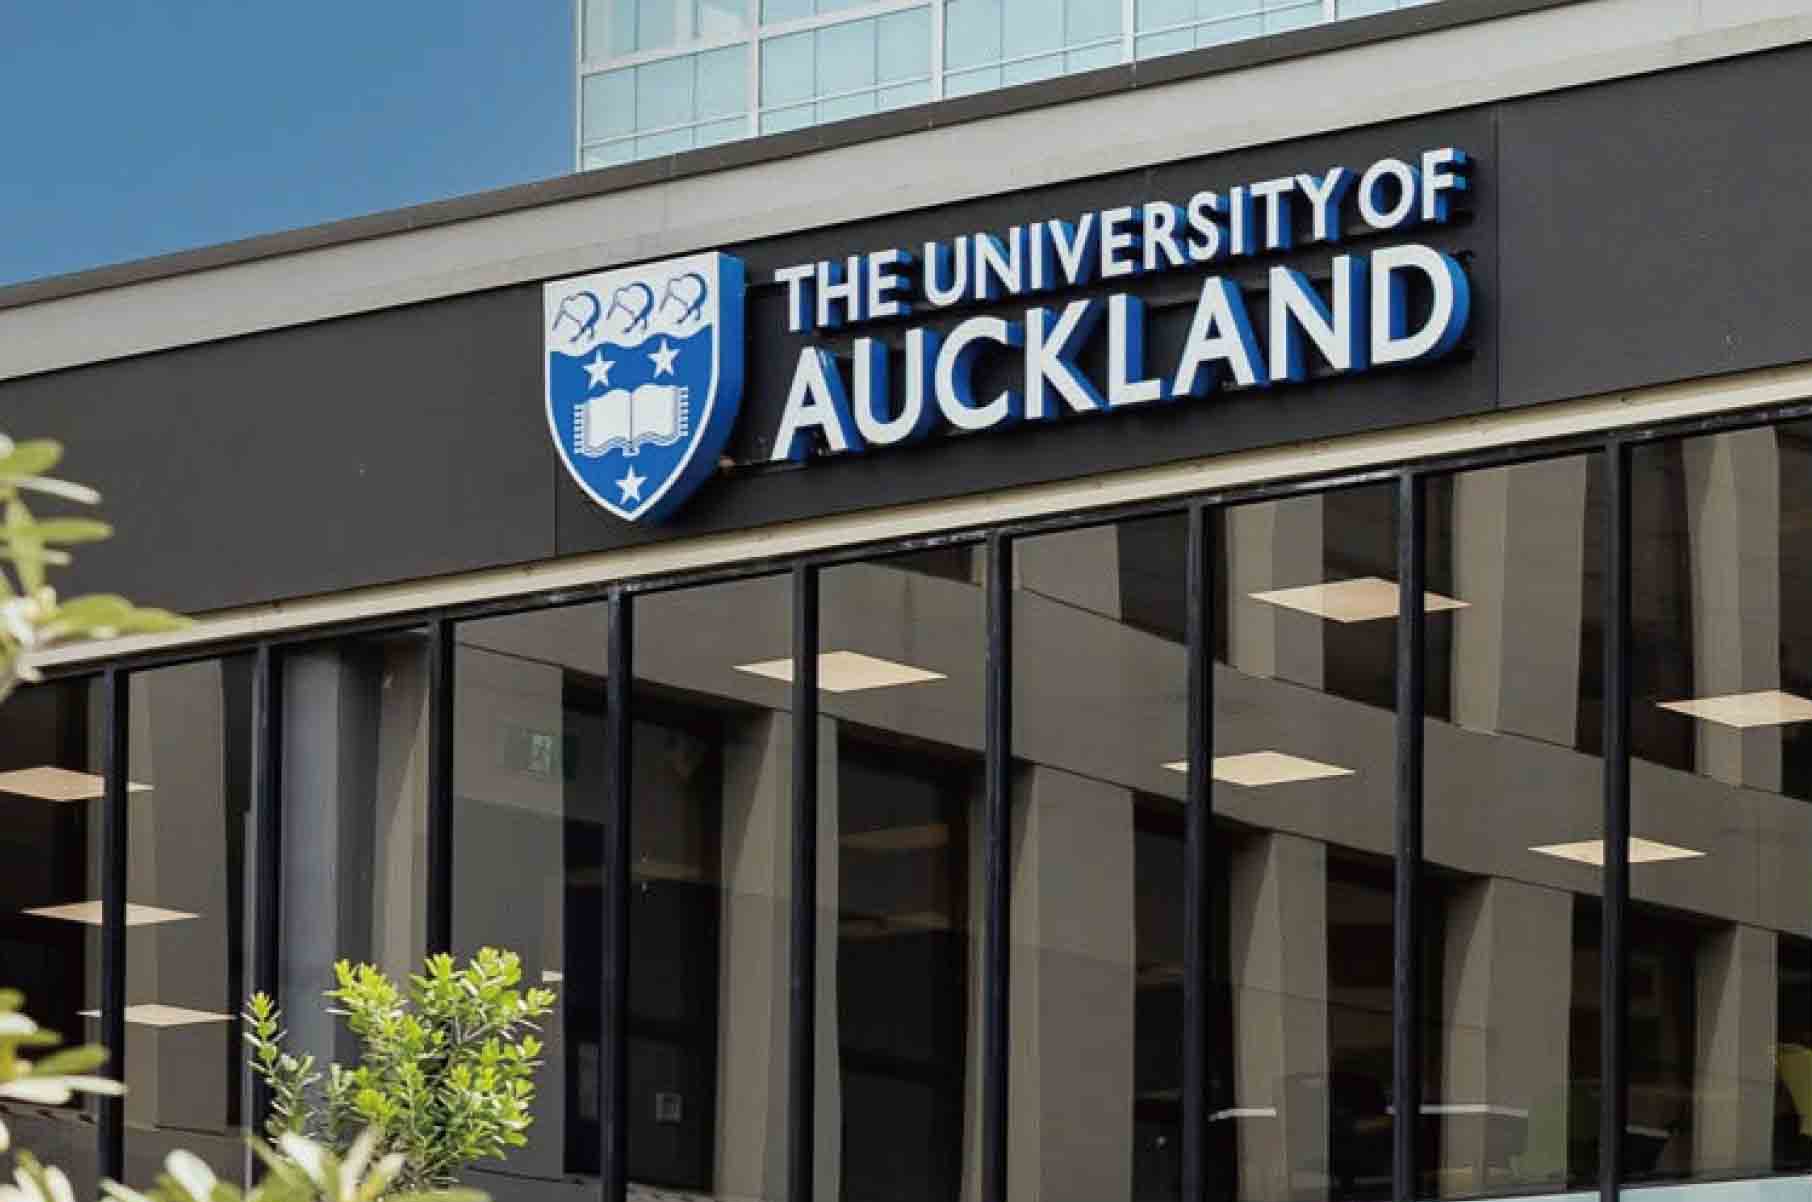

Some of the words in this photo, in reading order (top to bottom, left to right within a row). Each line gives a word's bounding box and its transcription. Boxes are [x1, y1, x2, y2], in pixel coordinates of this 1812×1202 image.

[775, 256, 904, 331] THE
[922, 166, 1348, 307] UNIVERSITY
[1358, 147, 1463, 230] OF
[770, 244, 1464, 462] AUCKLAND
